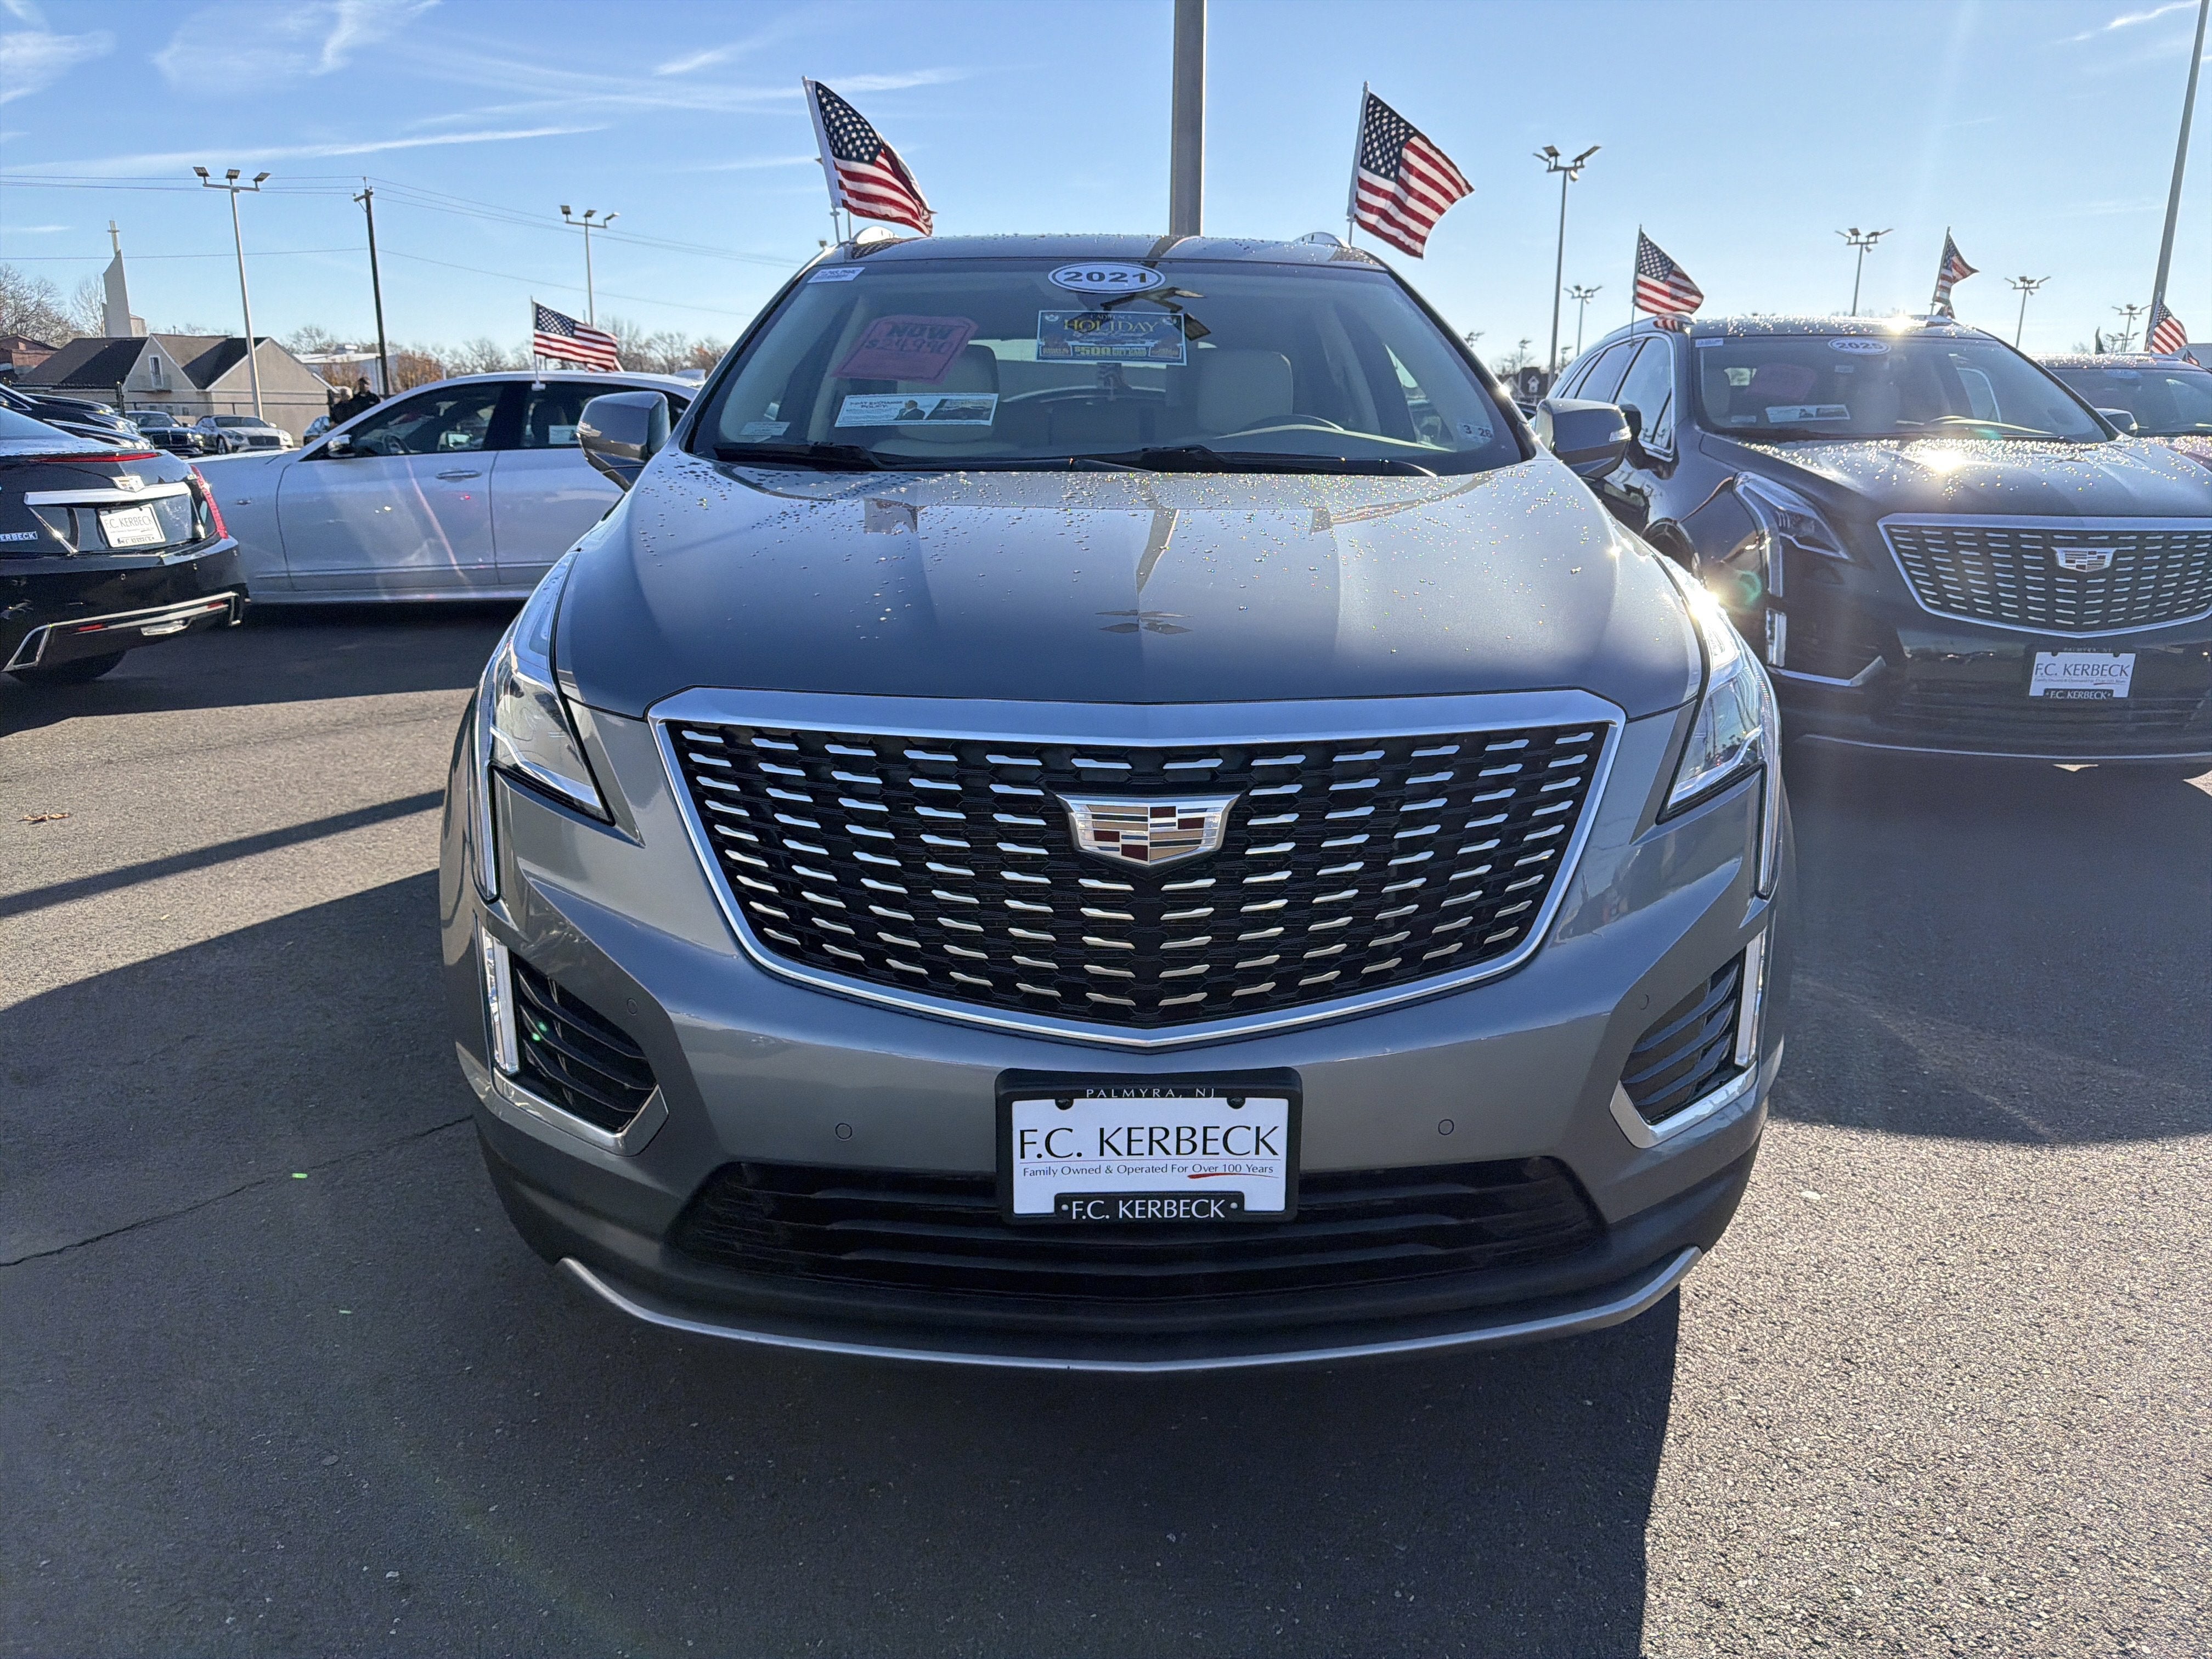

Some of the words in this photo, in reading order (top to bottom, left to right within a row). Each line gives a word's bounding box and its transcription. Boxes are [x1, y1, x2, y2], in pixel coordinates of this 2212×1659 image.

[1063, 271, 1146, 283] 2021
[886, 323, 955, 340] NOW
[1063, 319, 1159, 332] HOLIDAY
[1074, 346, 1111, 356] $500
[1463, 425, 1472, 435] 3
[119, 515, 154, 528] KERBECK
[0, 531, 36, 541] ERBECK
[2034, 663, 2057, 676] F.C.
[2063, 663, 2130, 677] KERBECK
[2067, 691, 2107, 699] KERBECK
[1086, 1088, 1183, 1099] PALMYRA,
[1196, 1088, 1216, 1098] NJ
[1019, 1127, 1083, 1159] F.C.
[1099, 1125, 1279, 1157] KERBECK
[1023, 1166, 1058, 1177] Family
[1061, 1165, 1101, 1175] Owned
[1105, 1165, 1113, 1174] &
[1117, 1164, 1167, 1176] Operated
[1171, 1164, 1188, 1173] For
[1192, 1164, 1218, 1173] Over
[1222, 1164, 1242, 1172] 100
[1246, 1164, 1273, 1173] Years
[1072, 1200, 1109, 1220] F.C.
[1119, 1199, 1226, 1219] KERBECK
